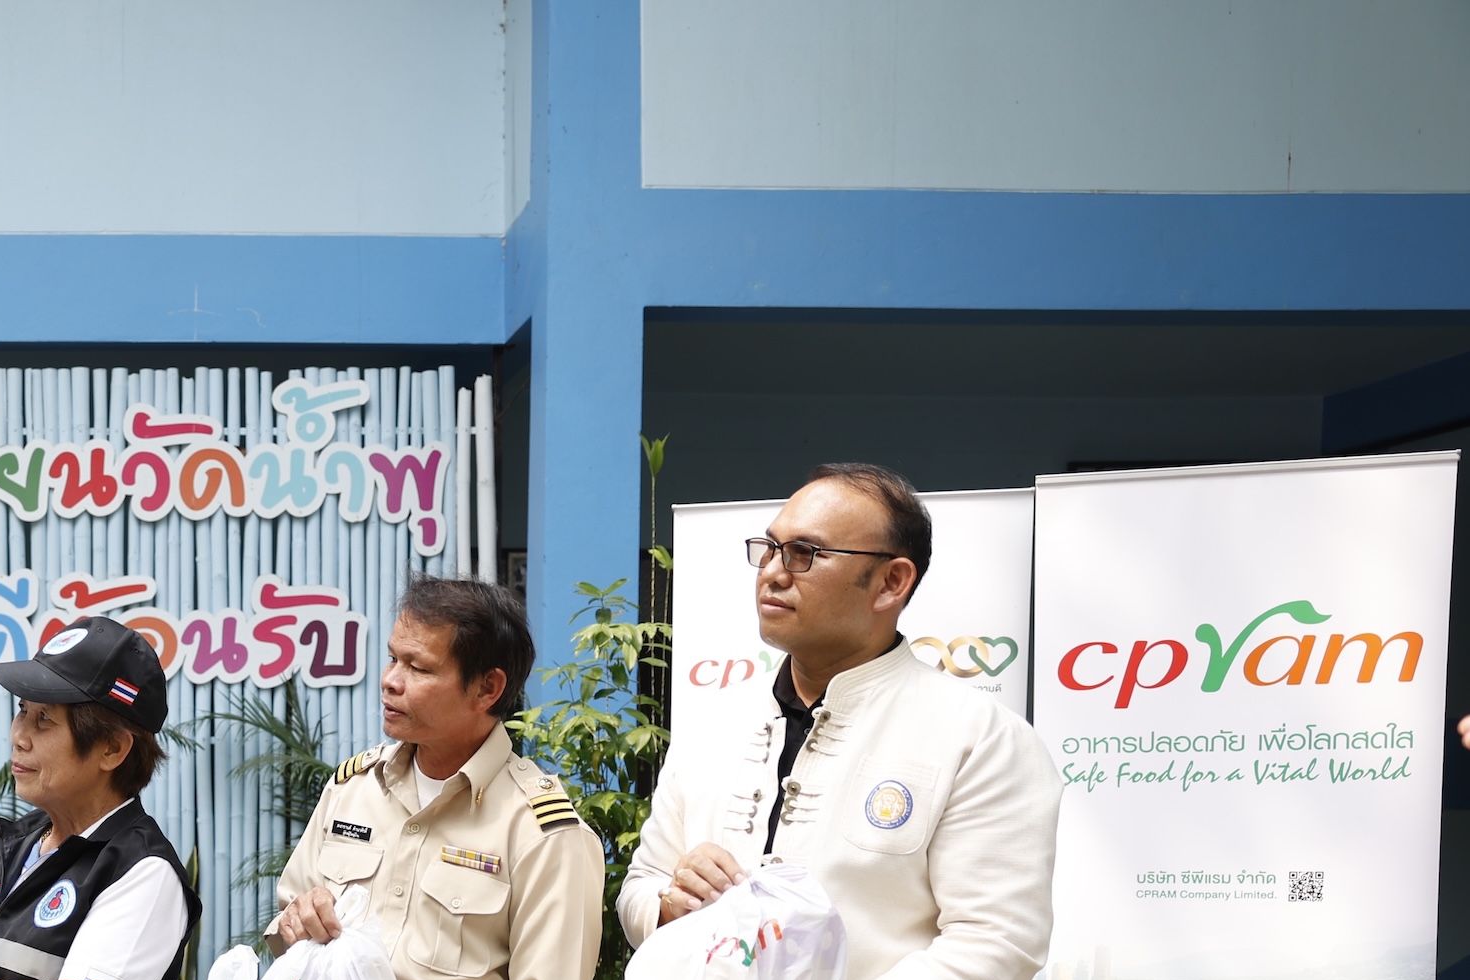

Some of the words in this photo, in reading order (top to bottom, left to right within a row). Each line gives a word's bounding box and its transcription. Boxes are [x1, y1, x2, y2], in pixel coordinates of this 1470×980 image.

[1057, 600, 1424, 709] cpram
[1062, 729, 1246, 755] อาหารปลอดภัย
[1257, 722, 1414, 752] เพื่อโลกสดใส
[1062, 760, 1108, 792] Safe
[1116, 760, 1176, 788] Food
[1179, 759, 1220, 792] for
[1225, 765, 1245, 782] a
[1253, 757, 1320, 784] Vital
[1328, 756, 1412, 784] World
[1136, 871, 1176, 885] บริษัท
[1180, 870, 1231, 885] ซีพีแรม
[1236, 869, 1276, 885] จำกัด
[1136, 890, 1177, 899] CPRAM
[1180, 890, 1231, 901] Company
